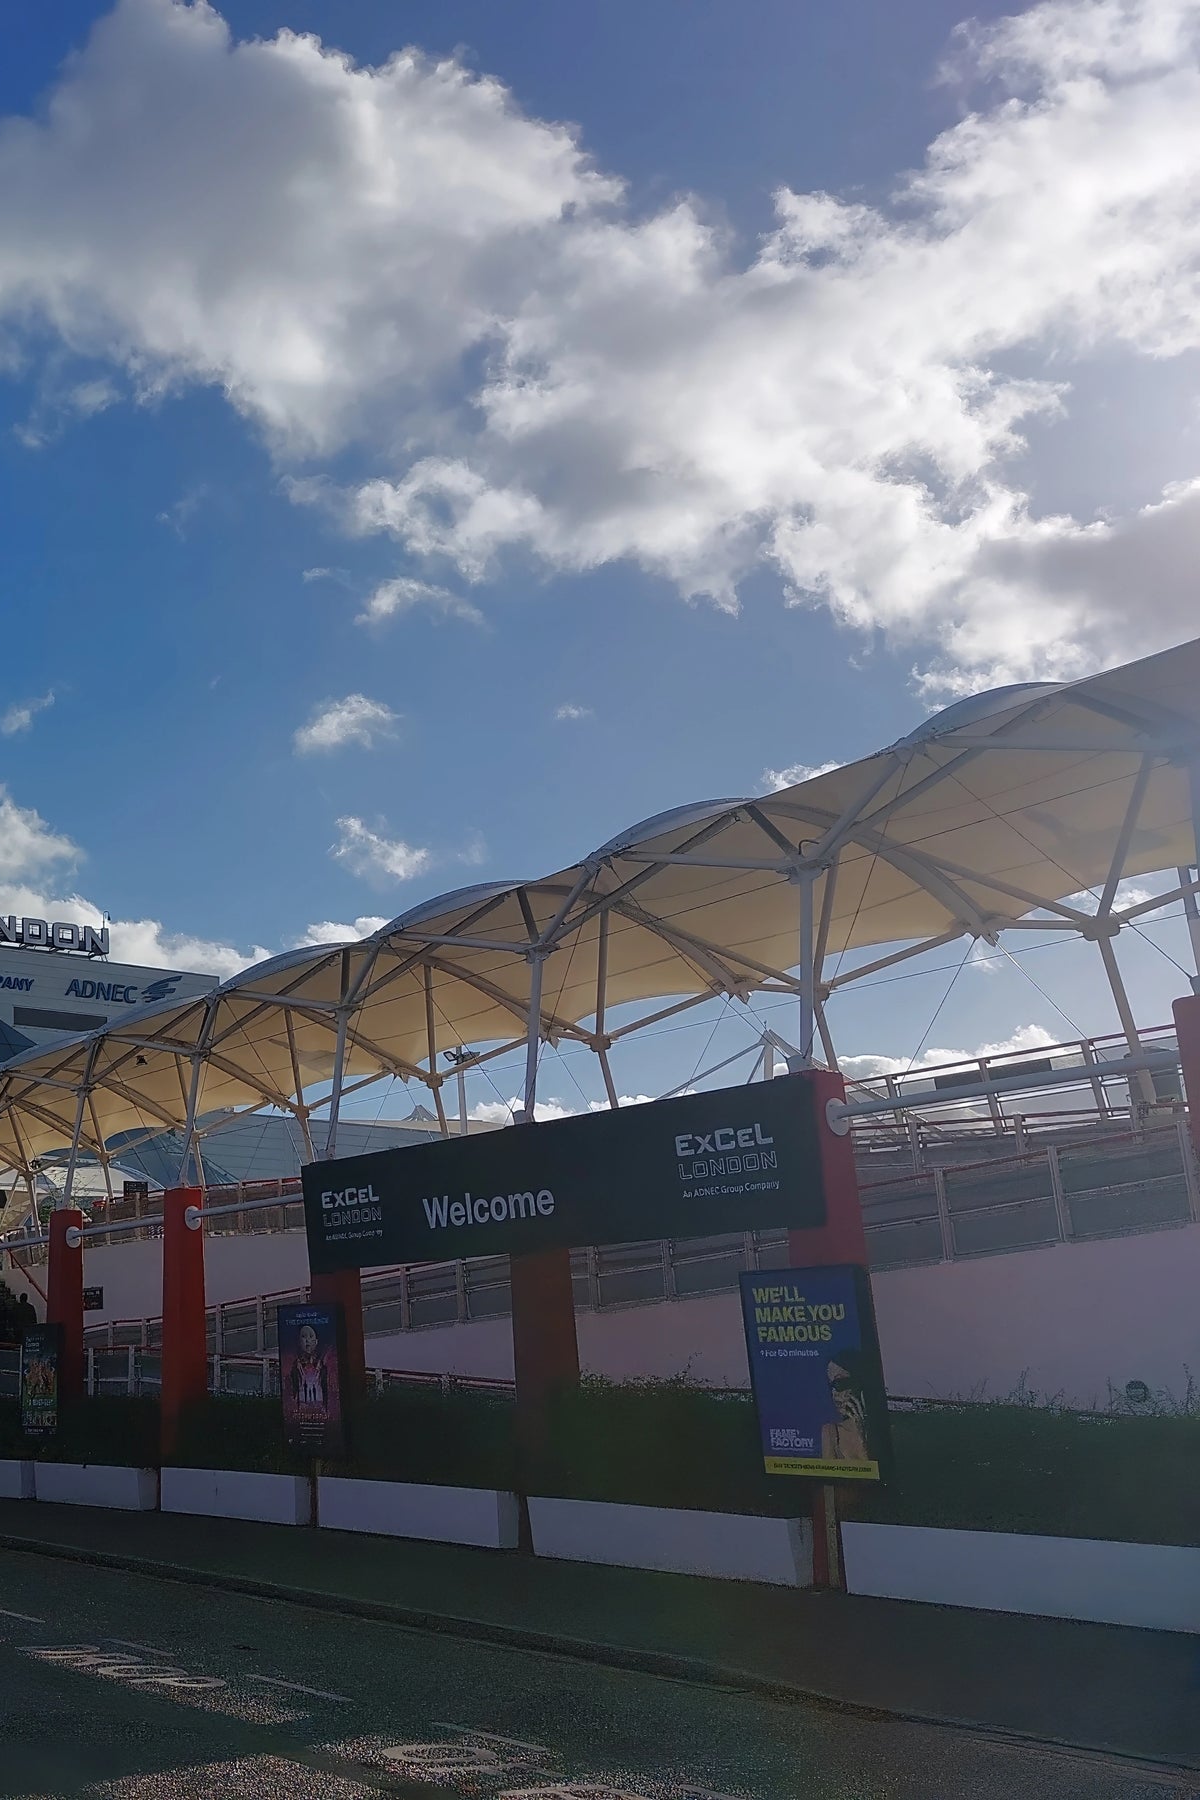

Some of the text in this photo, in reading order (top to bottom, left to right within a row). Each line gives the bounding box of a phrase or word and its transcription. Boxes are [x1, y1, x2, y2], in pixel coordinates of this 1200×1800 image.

[64, 978, 138, 1004] ADNEC
[678, 1150, 778, 1180] LONDON
[682, 1180, 780, 1199] An ADNEC Group Company
[322, 1206, 382, 1228] LONDON
[421, 1189, 556, 1230] Welcome
[751, 1285, 806, 1304] WE'LL
[754, 1303, 846, 1324] MAKE YOU
[757, 1324, 833, 1343] FAMOUS
[770, 1437, 814, 1448] FACTORY
[14, 1643, 227, 1688] DROP
